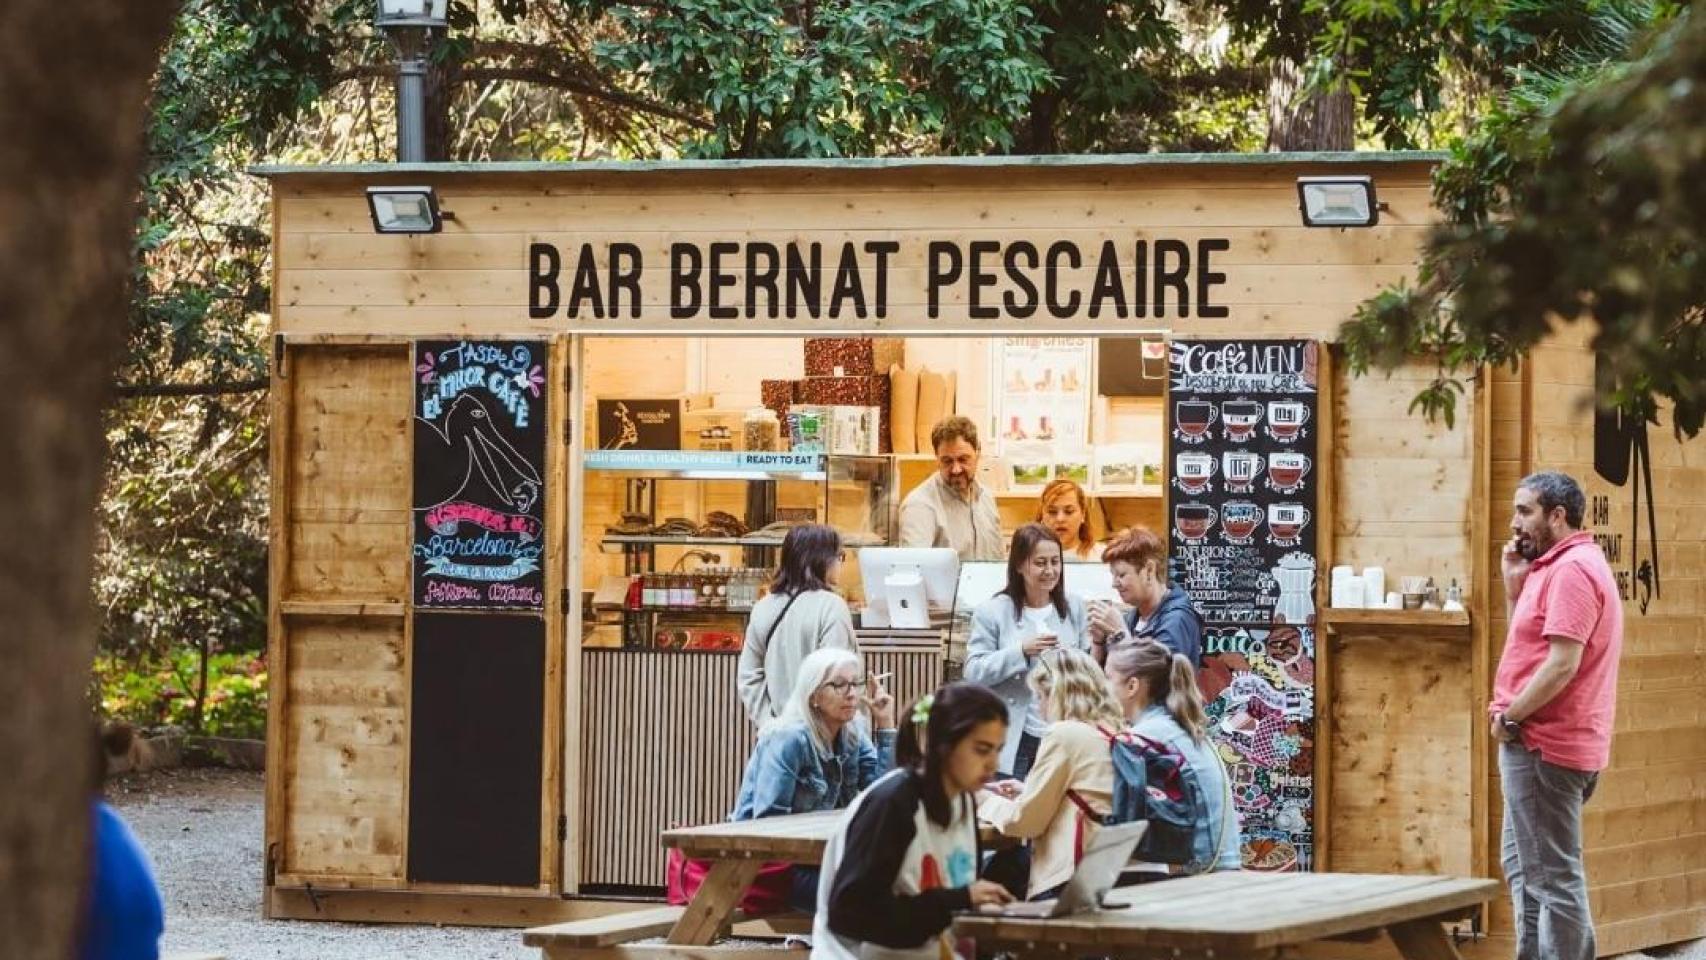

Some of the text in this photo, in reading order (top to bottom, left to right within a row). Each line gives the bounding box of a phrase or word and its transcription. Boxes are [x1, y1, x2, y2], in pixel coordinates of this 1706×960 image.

[529, 239, 1229, 318] BAR BERNAT PESCAIRE
[440, 366, 486, 400] MILLOR
[746, 455, 777, 465] READY
[780, 455, 793, 465] TO
[795, 455, 812, 465] EAT
[1593, 496, 1609, 525] BAR
[429, 531, 516, 557] Barcelona
